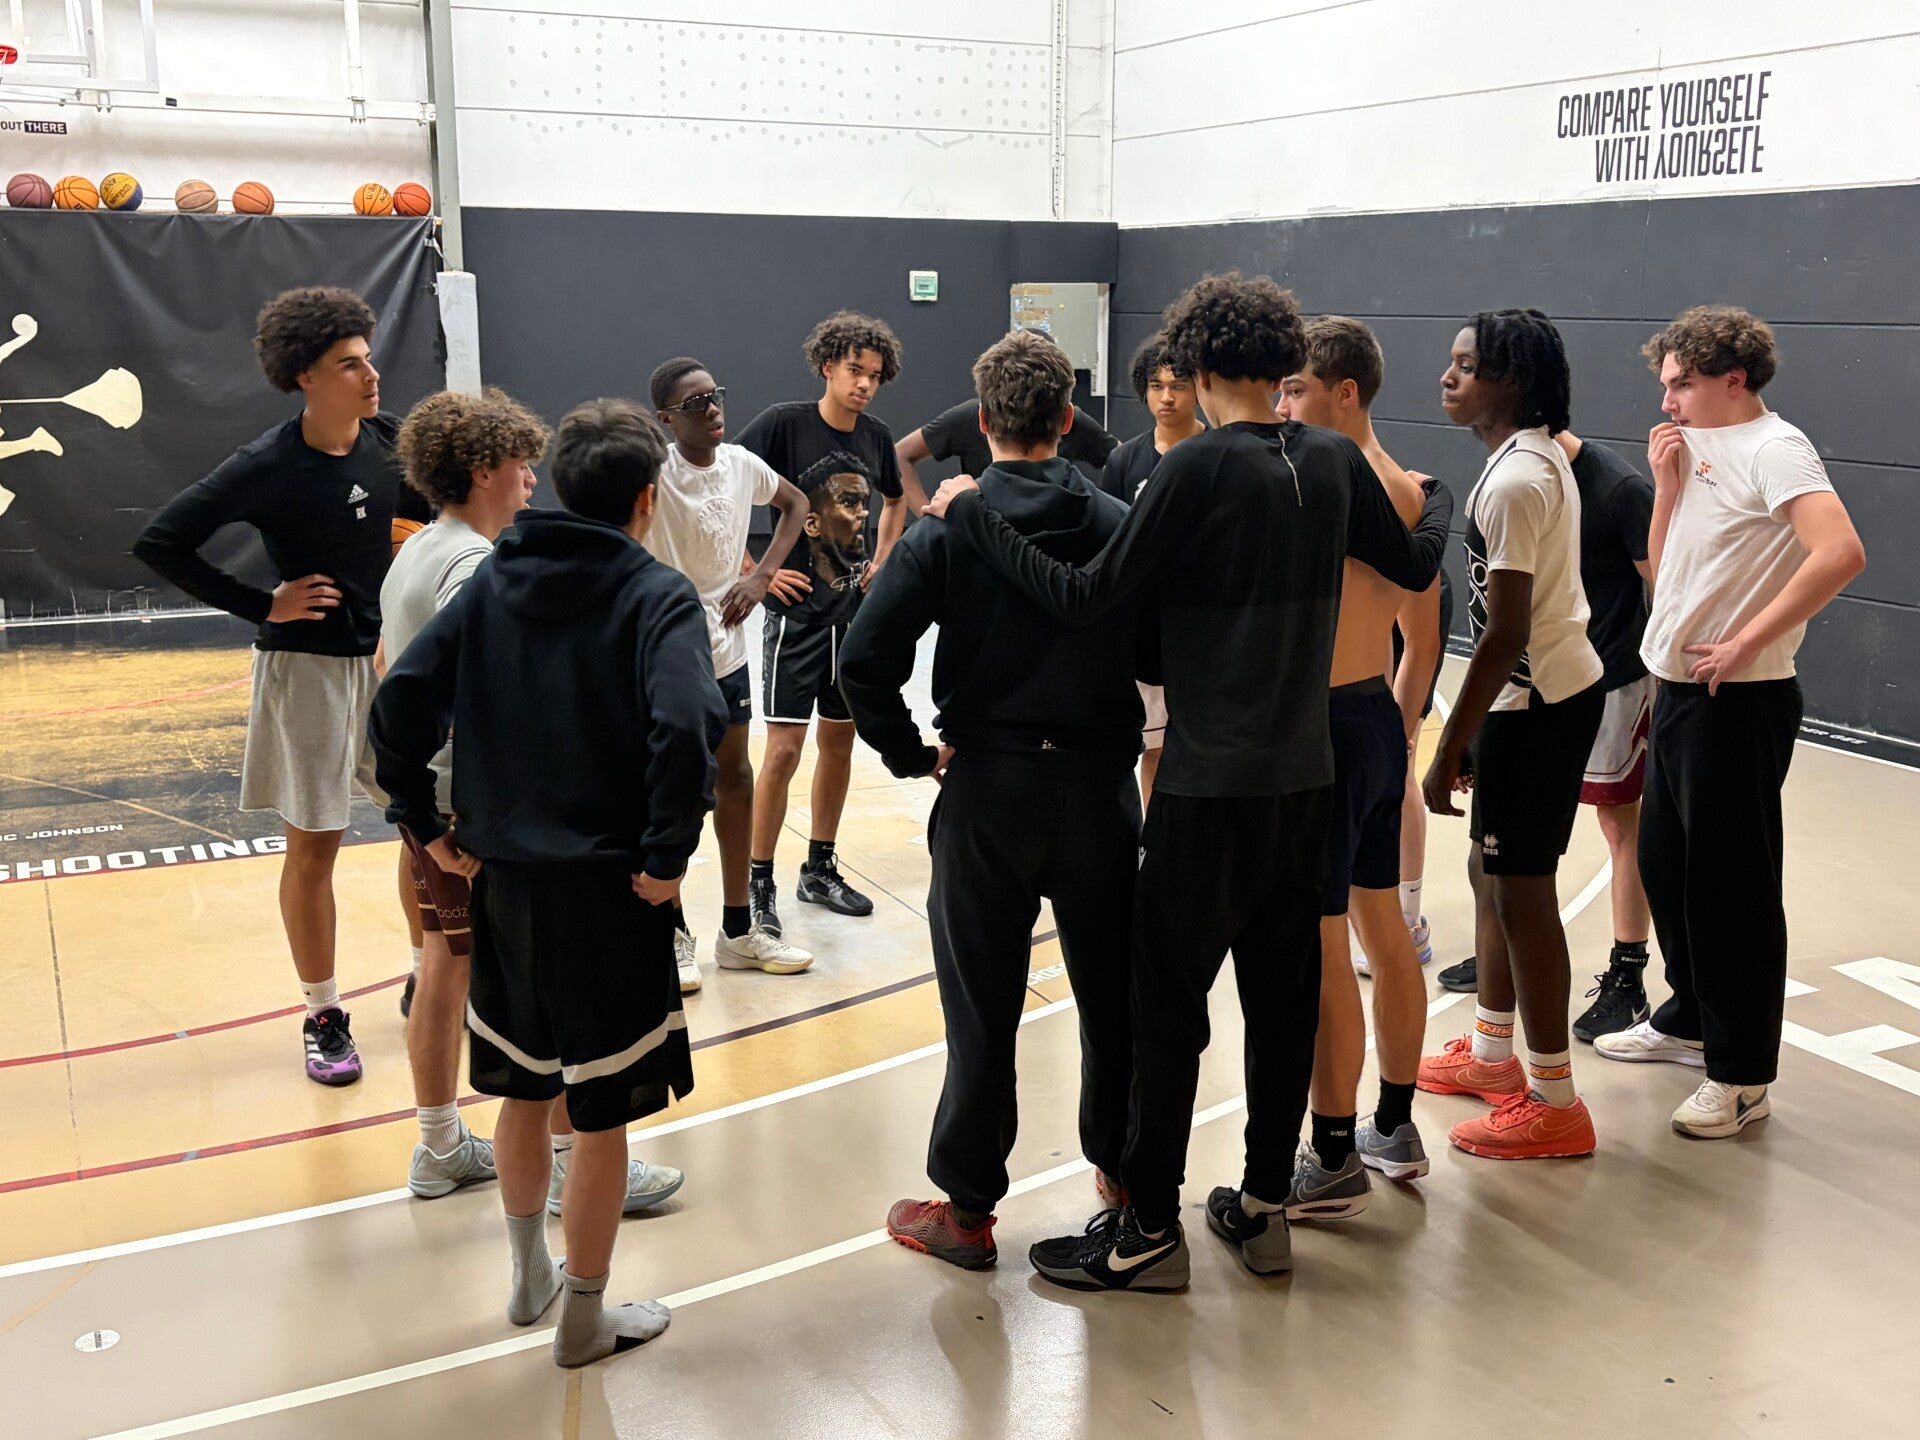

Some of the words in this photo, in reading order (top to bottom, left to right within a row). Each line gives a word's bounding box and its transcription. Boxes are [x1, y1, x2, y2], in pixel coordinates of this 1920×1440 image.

[0, 121, 22, 131] OUT
[26, 121, 65, 133] THERE
[1557, 85, 1653, 139] COMPARE
[1659, 70, 1772, 129] YOURSELF
[1596, 135, 1649, 183] WITH
[25, 823, 124, 840] JOHNSON
[0, 835, 287, 881] HOOTING
